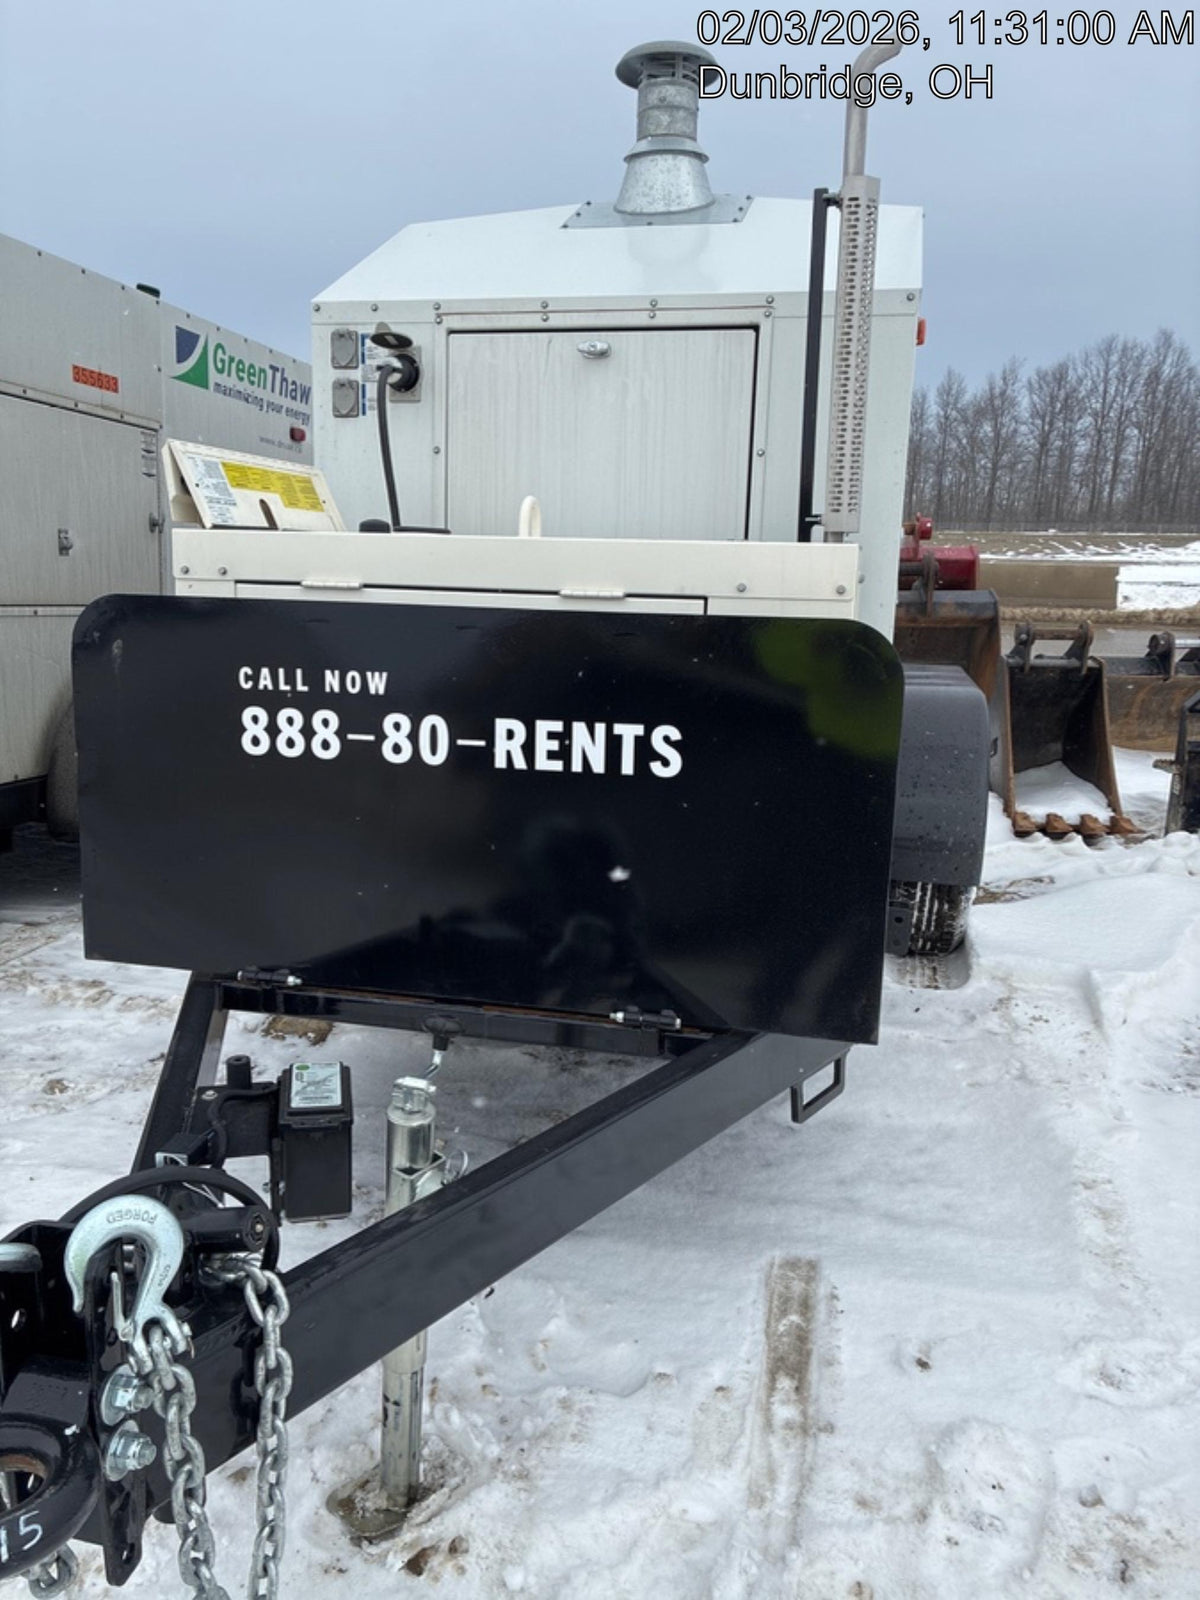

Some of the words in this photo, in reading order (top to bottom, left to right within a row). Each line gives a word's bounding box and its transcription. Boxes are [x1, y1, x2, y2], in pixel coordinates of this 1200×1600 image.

[212, 341, 312, 406] GreenThaw
[265, 399, 284, 414] your
[284, 406, 311, 427] energy
[238, 666, 308, 693] CALL
[324, 670, 388, 695] NOW
[240, 705, 683, 779] 888-80-RENTS
[106, 1208, 158, 1224] FORGED
